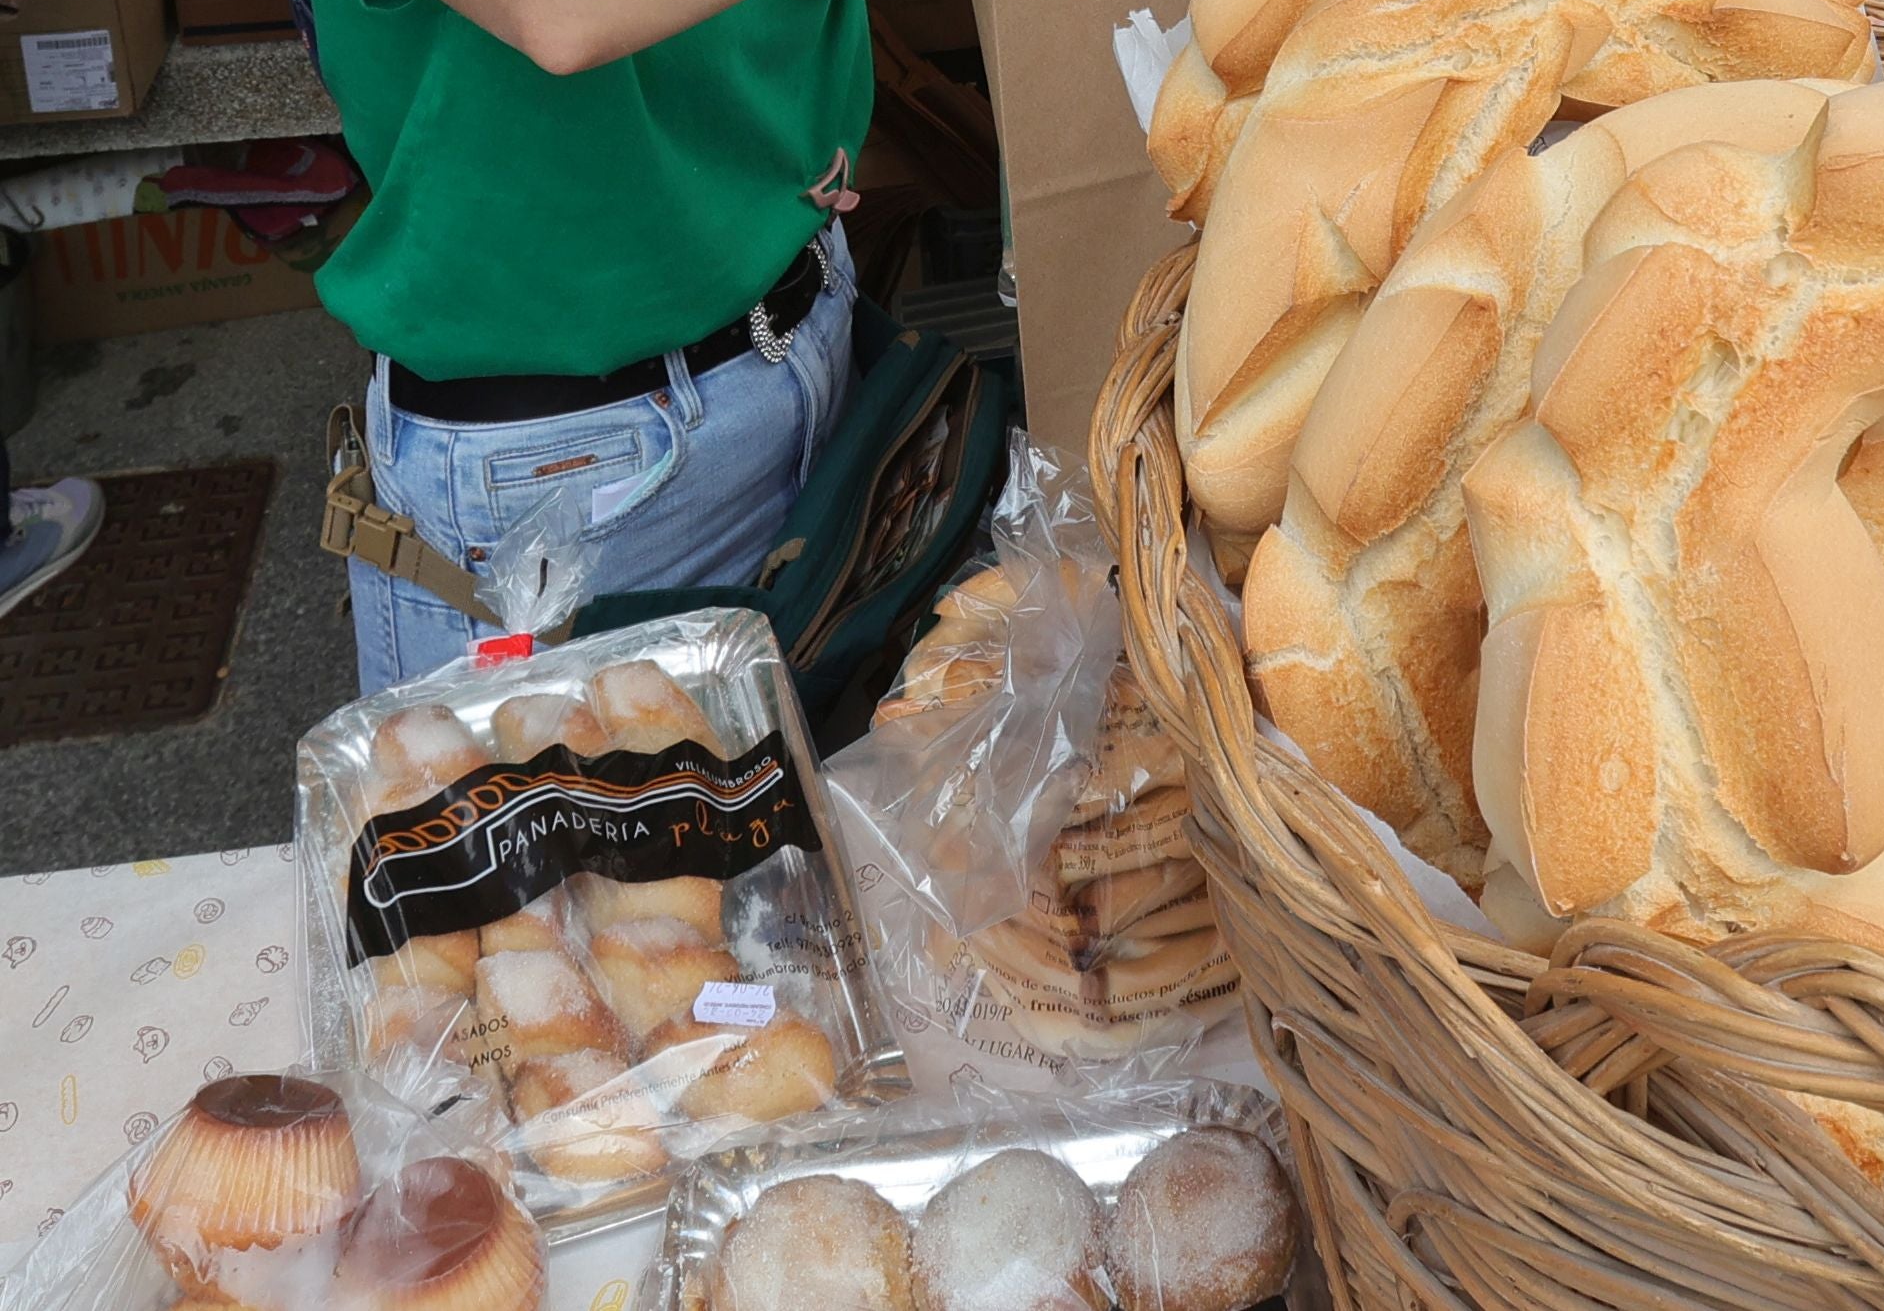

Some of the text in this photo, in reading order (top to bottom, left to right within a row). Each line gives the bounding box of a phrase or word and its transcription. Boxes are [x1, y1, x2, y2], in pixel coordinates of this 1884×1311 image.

[675, 755, 771, 788] VILLALUMBROSO
[844, 910, 854, 922] 2
[724, 962, 810, 984] Villalumbroso
[1021, 977, 1039, 992] de
[1042, 982, 1079, 1003] estos
[1082, 987, 1155, 1008] productos
[1030, 998, 1081, 1017] frutos
[1085, 1010, 1105, 1023] de
[1177, 978, 1238, 1009] sésamo
[977, 1037, 1036, 1065] LUGAR
[699, 1061, 731, 1081] Antes
